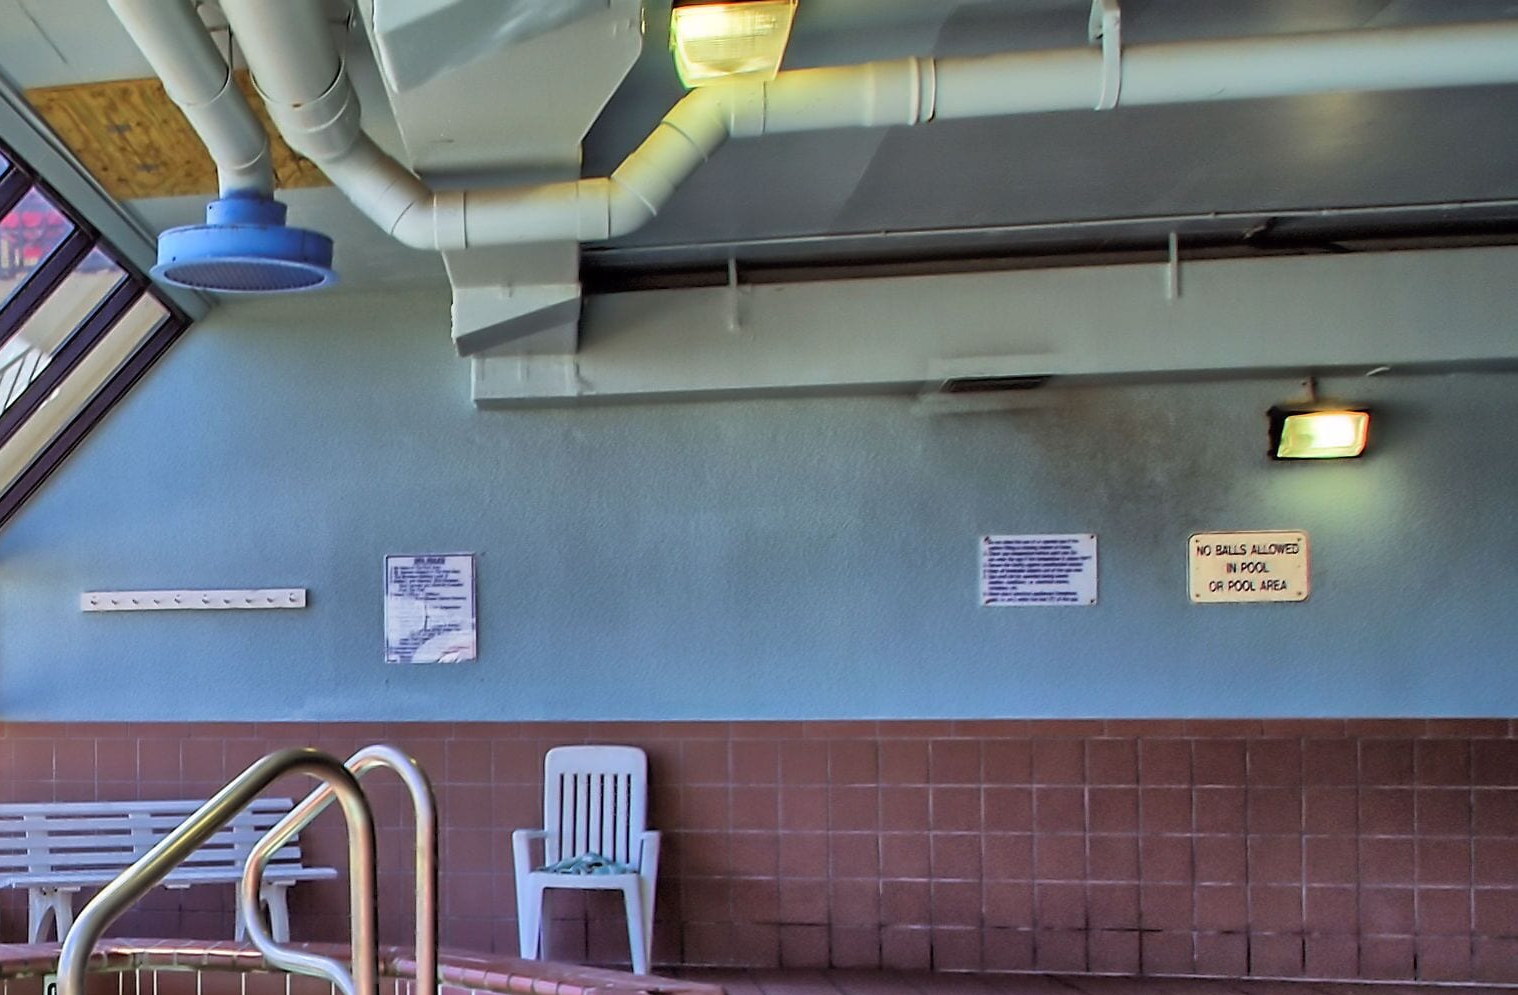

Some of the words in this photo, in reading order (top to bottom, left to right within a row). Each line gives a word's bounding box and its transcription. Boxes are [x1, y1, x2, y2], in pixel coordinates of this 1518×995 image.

[1196, 545, 1211, 556] NO
[1216, 544, 1247, 556] BALLS
[1250, 543, 1300, 555] ALLOWED
[1226, 562, 1237, 573] IN
[1241, 562, 1269, 573] POOL
[1209, 581, 1224, 592] OR
[1228, 580, 1256, 592] POOL
[1260, 579, 1287, 591] AREA
